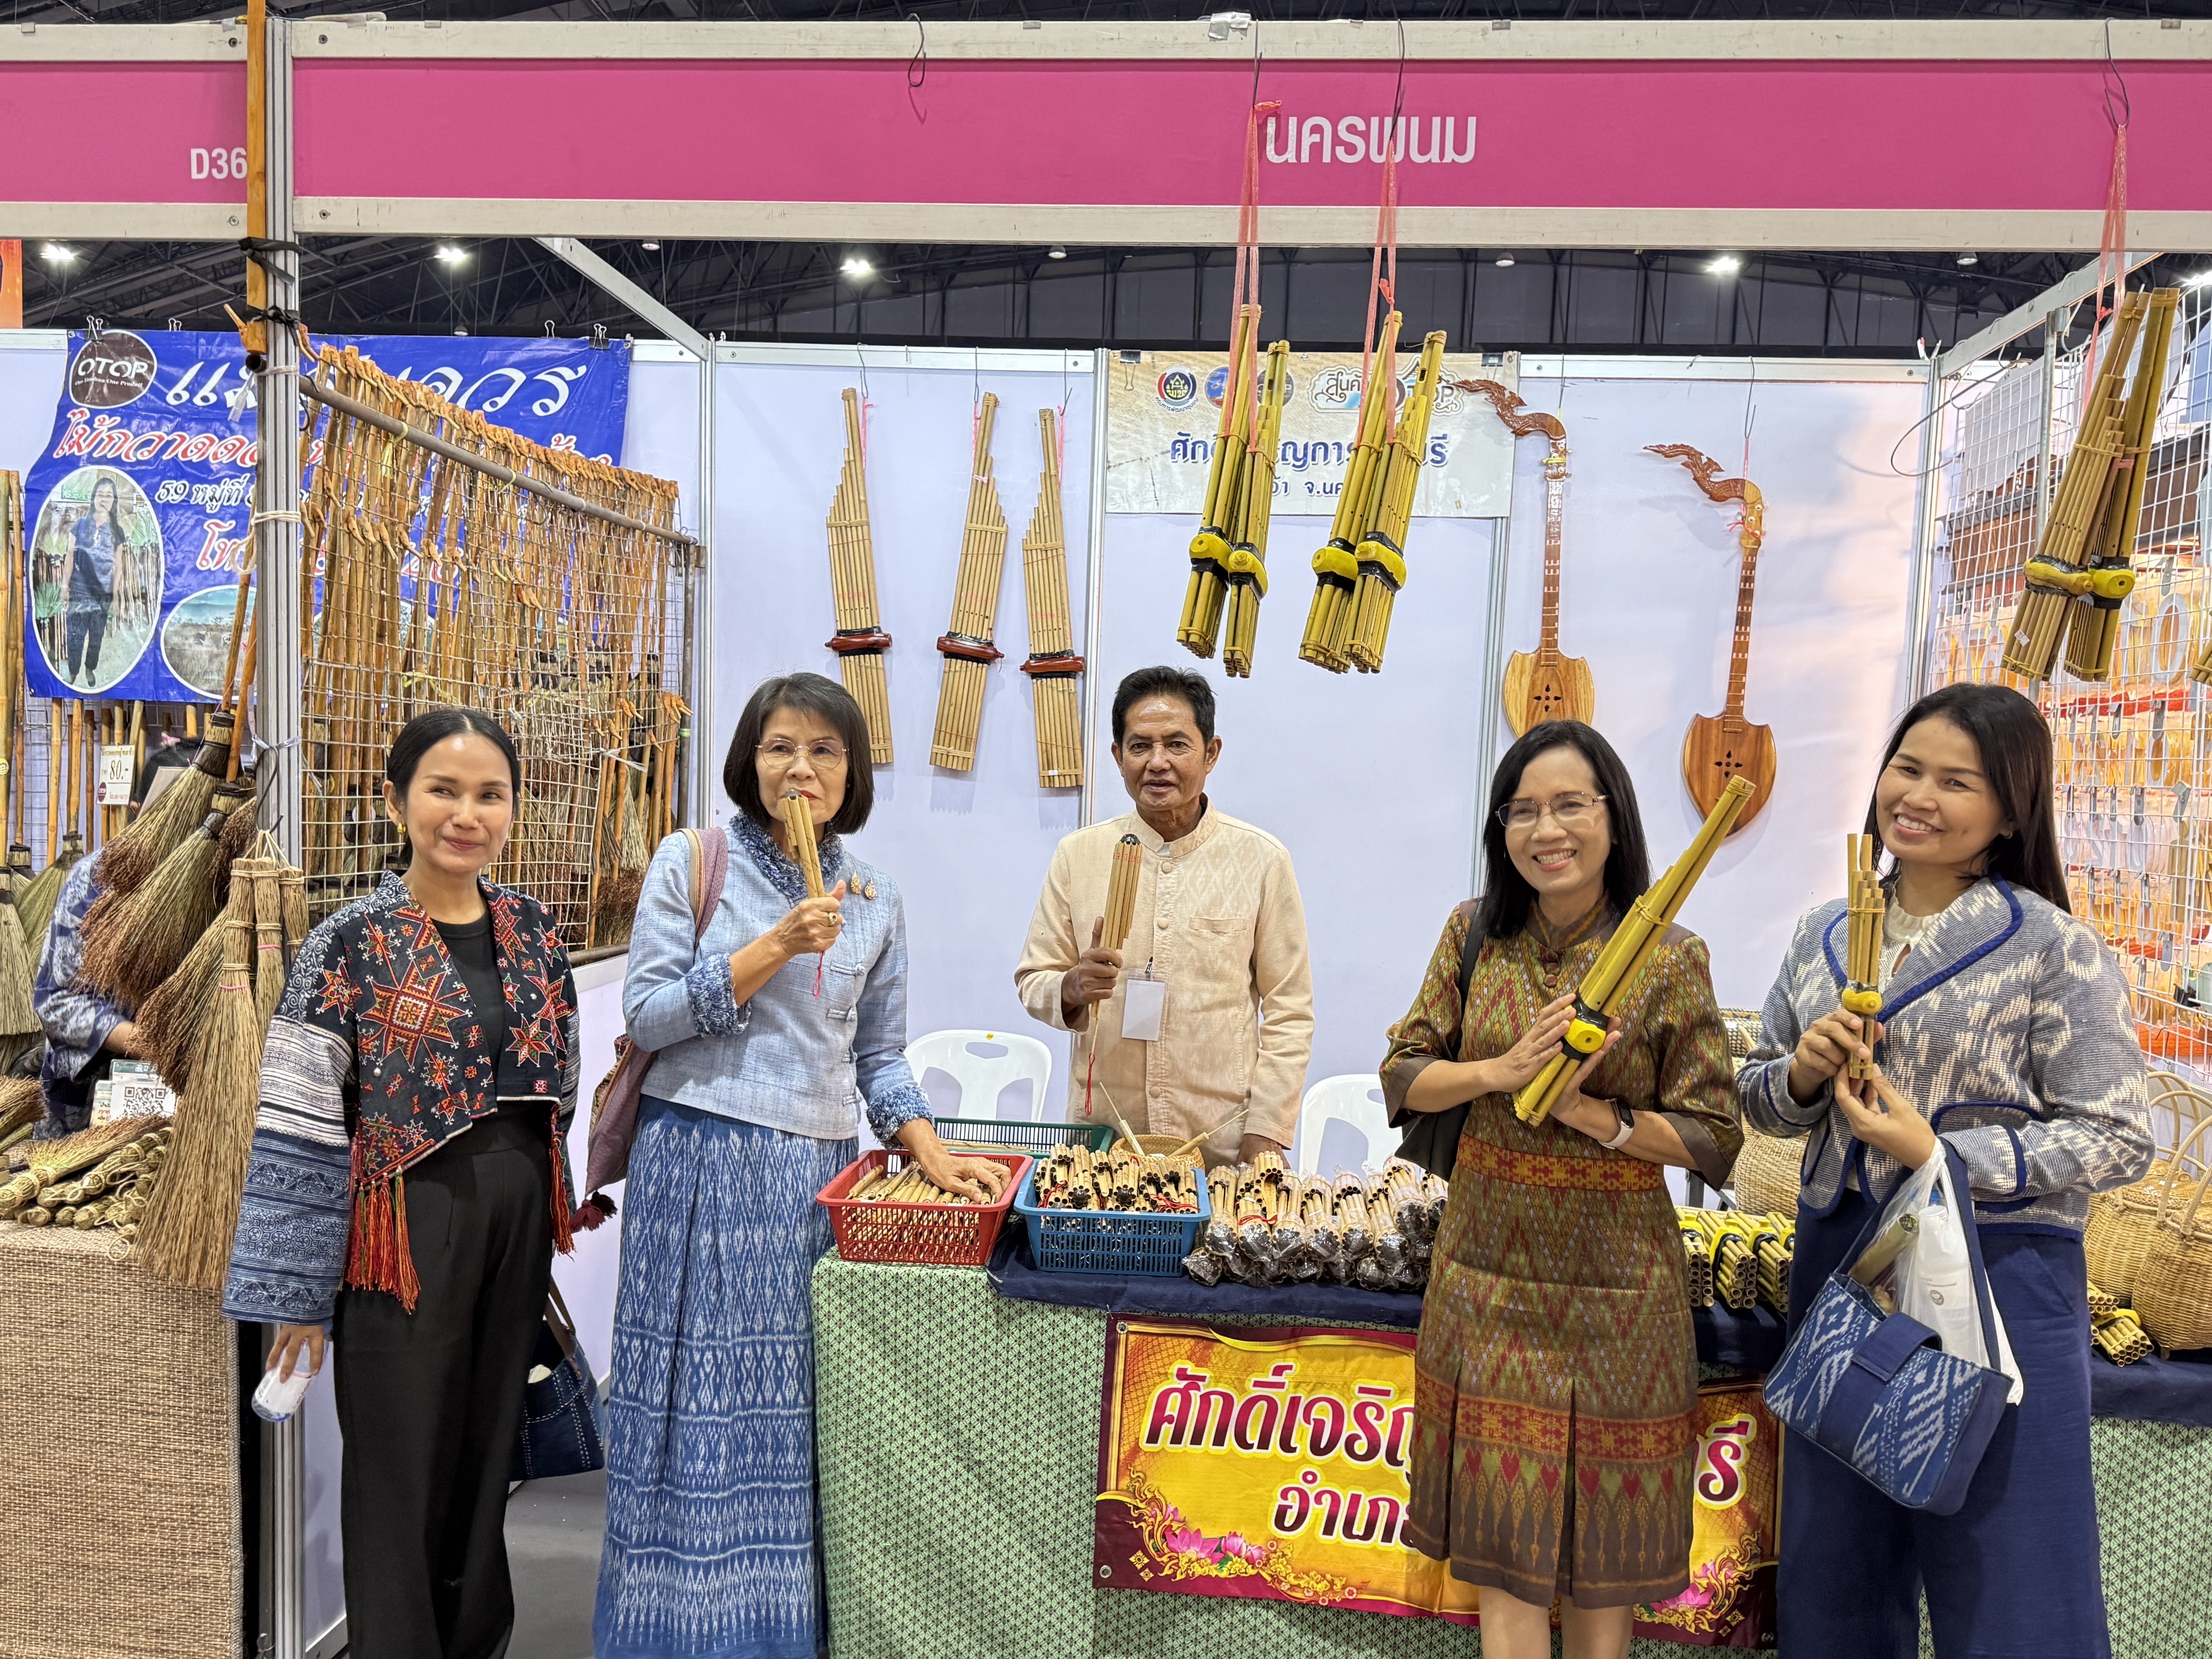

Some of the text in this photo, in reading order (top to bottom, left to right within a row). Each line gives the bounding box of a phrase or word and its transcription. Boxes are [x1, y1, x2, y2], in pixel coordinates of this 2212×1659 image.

[1266, 116, 1476, 163] นครพนม
[191, 147, 247, 179] D36
[78, 357, 148, 379] OTOP
[155, 480, 189, 504] 59
